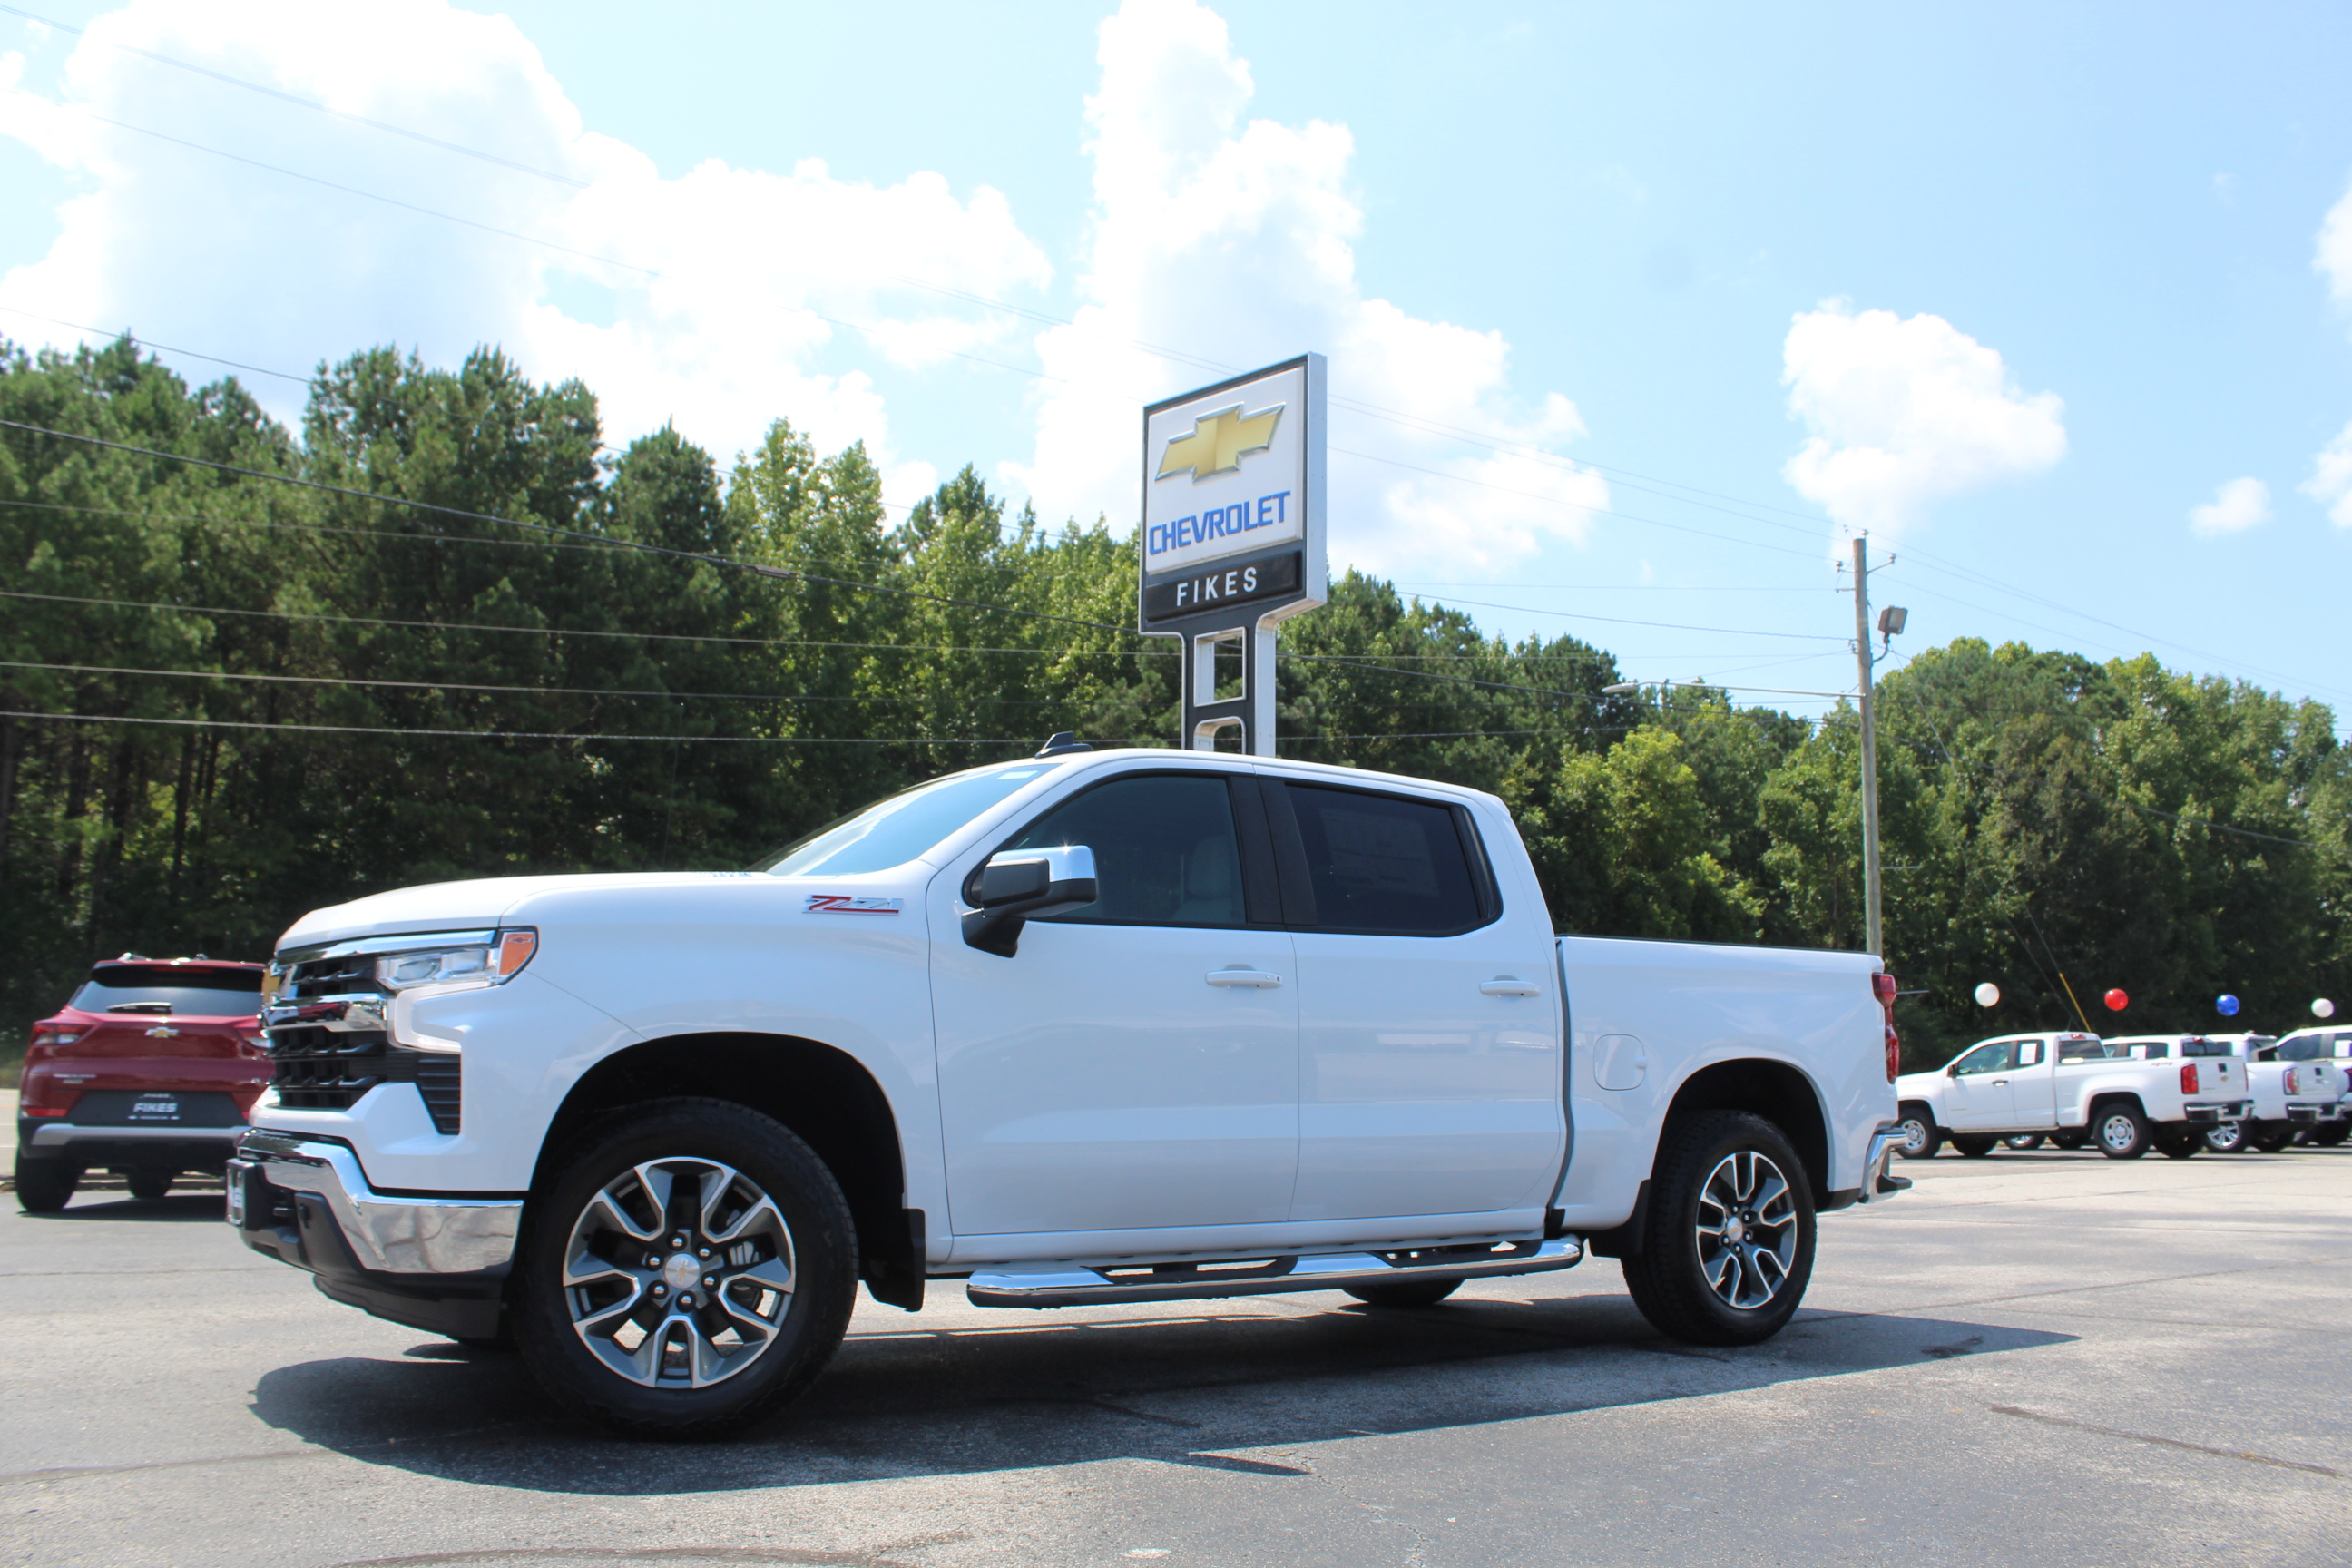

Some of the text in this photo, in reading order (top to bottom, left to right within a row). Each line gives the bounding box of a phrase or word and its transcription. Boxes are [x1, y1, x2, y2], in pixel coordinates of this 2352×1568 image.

[1149, 491, 1290, 555] CHEVROLET
[1176, 567, 1258, 607] FIKES
[132, 1102, 179, 1112] FIKES
